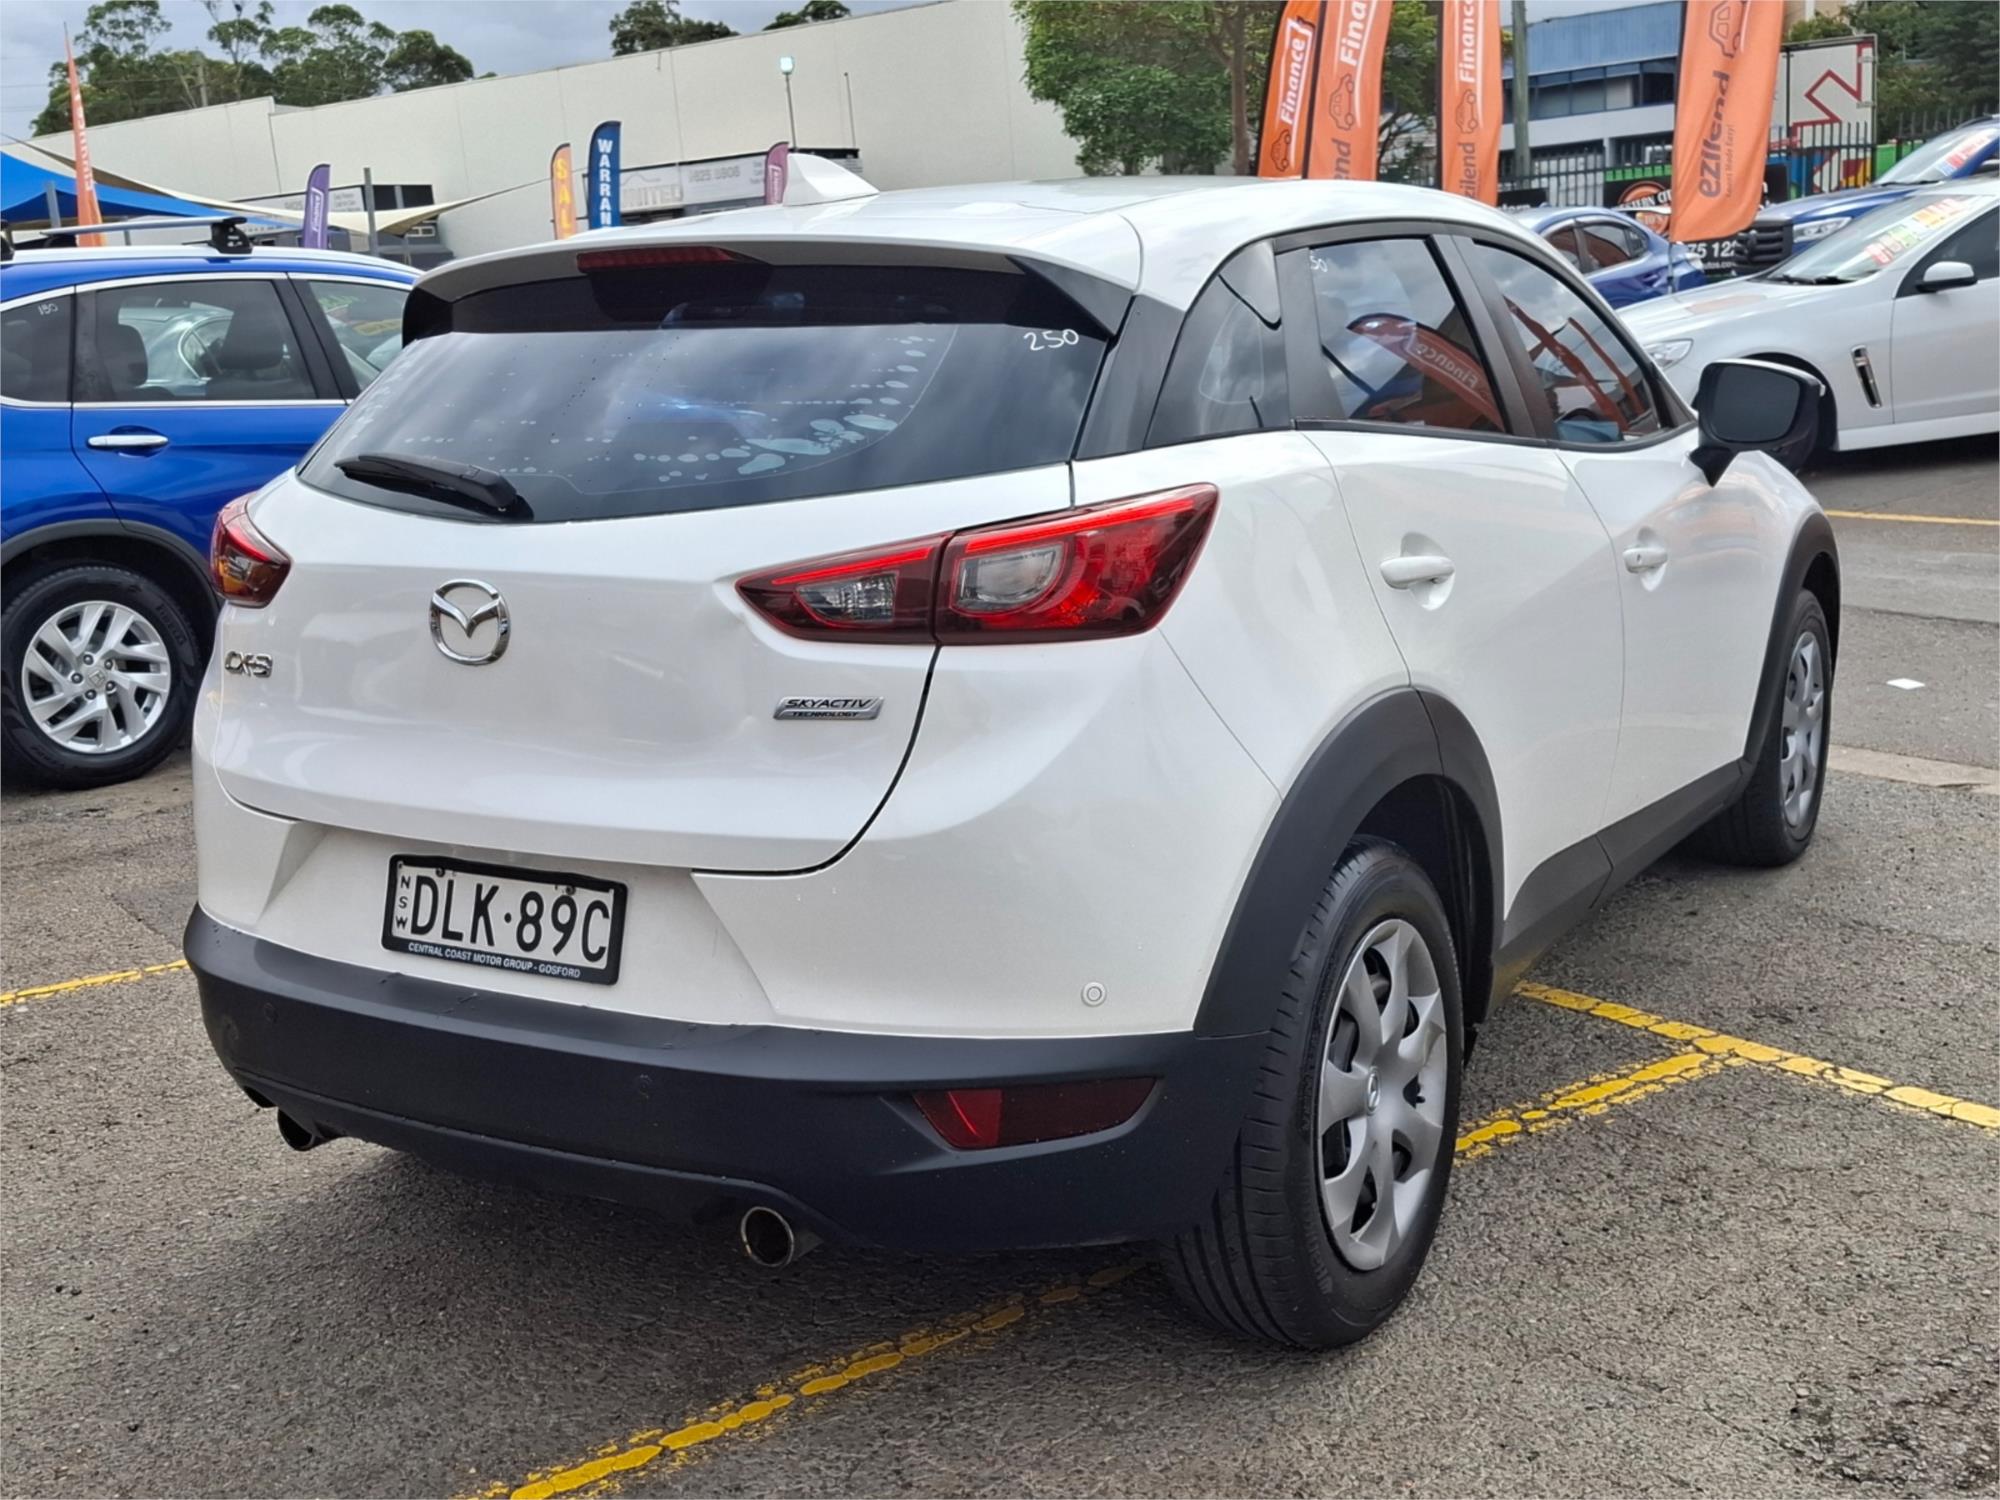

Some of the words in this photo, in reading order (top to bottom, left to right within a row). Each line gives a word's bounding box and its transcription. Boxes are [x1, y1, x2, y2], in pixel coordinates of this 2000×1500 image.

[1280, 38, 1306, 125] Finance
[1700, 70, 1731, 198] ezilend
[598, 139, 613, 227] WARRAN
[1023, 328, 1079, 351] 250
[785, 698, 872, 708] SKYACTIV
[408, 941, 443, 957] CENTRAL
[444, 947, 472, 961] COAST
[473, 952, 502, 967] MOTOR
[503, 958, 533, 971] GROUP
[538, 963, 581, 978] GOSFORD
